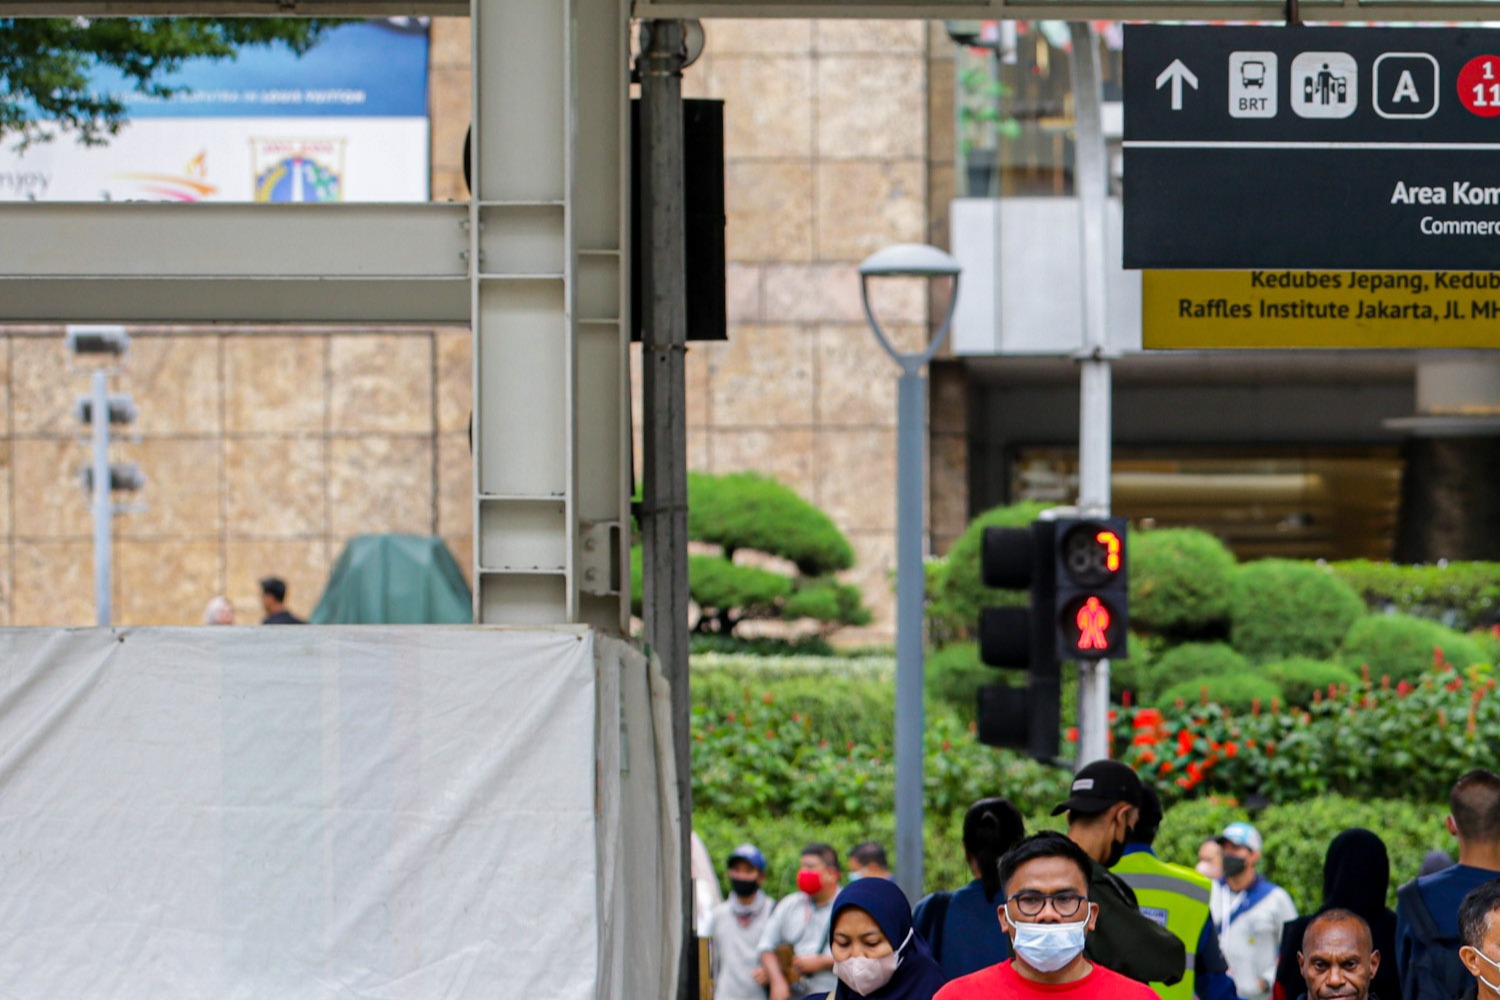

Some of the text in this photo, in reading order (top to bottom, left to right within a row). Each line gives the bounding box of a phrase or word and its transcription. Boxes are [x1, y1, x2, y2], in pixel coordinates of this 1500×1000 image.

[1481, 61, 1495, 79] 1
[1391, 70, 1421, 103] A
[1238, 98, 1268, 111] BRT
[1390, 181, 1447, 205] Area
[1251, 271, 1343, 289] Kedubes
[1347, 271, 1430, 294] Jepang,
[1179, 299, 1252, 319] Raffles
[1259, 299, 1350, 319] Institute
[1355, 300, 1439, 322] Jakarta,
[1443, 301, 1466, 319] Jl.
[1096, 531, 1120, 571] 7
